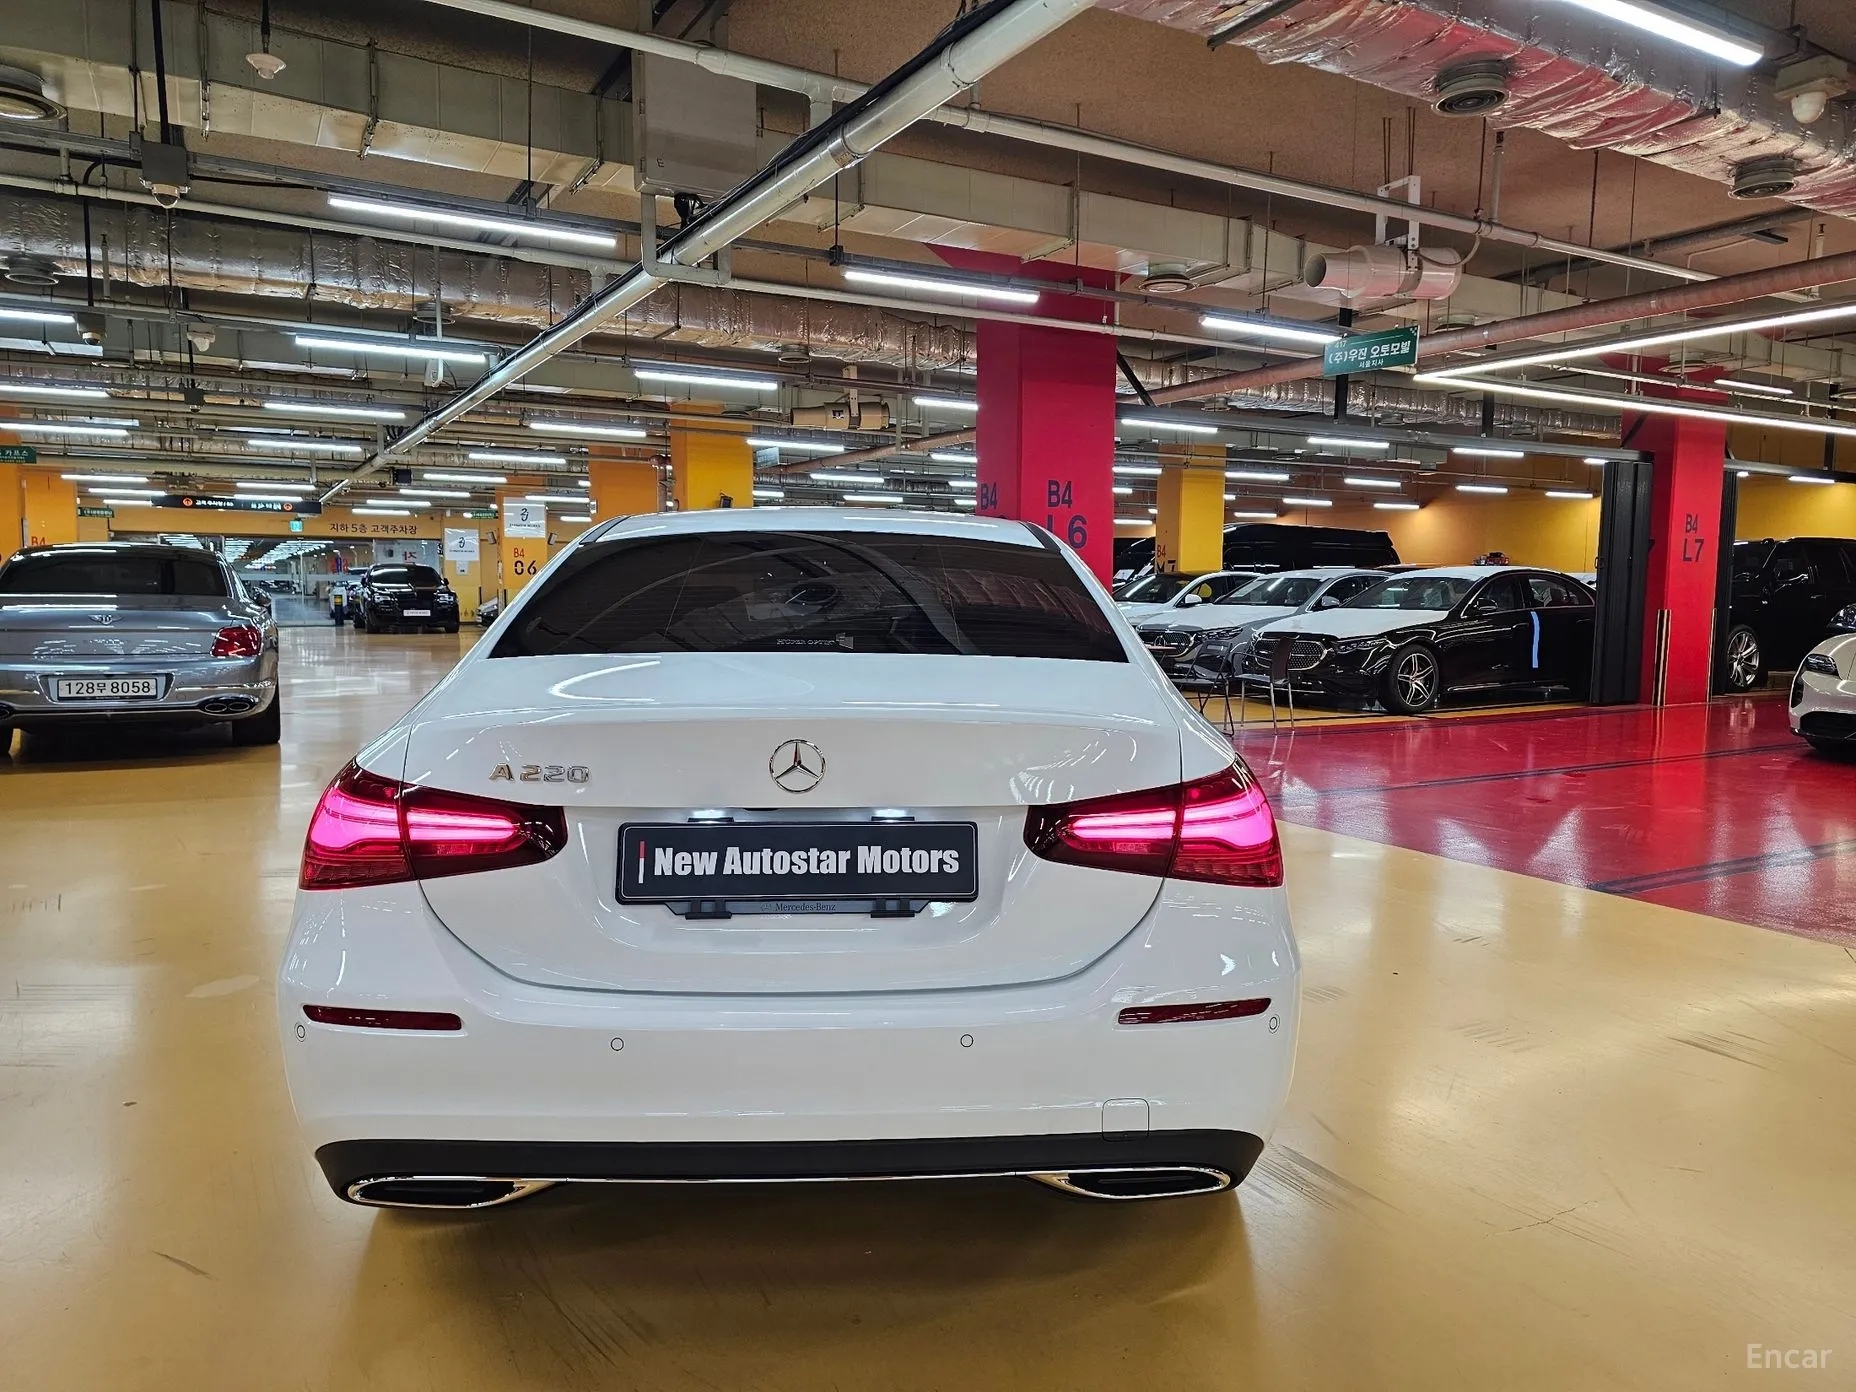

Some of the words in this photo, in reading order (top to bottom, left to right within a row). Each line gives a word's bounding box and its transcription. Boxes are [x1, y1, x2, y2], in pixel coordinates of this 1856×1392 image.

[1328, 347, 1367, 365] (주)우진
[1370, 340, 1411, 359] 오토모빌
[980, 482, 998, 511] B4
[1047, 479, 1073, 509] B4
[330, 523, 349, 533] 지하
[351, 523, 368, 534] 5층
[1684, 513, 1698, 533] B4
[513, 547, 525, 558] B4
[1156, 544, 1166, 558] B4
[1682, 538, 1705, 562] L7
[65, 682, 106, 695] 128무
[110, 681, 151, 694] 8058
[489, 763, 515, 781] A
[520, 764, 589, 784] 220
[654, 847, 717, 876] New
[723, 846, 850, 875] Autostar
[857, 845, 960, 874] Motors
[776, 902, 836, 912] Mercedes-Benz
